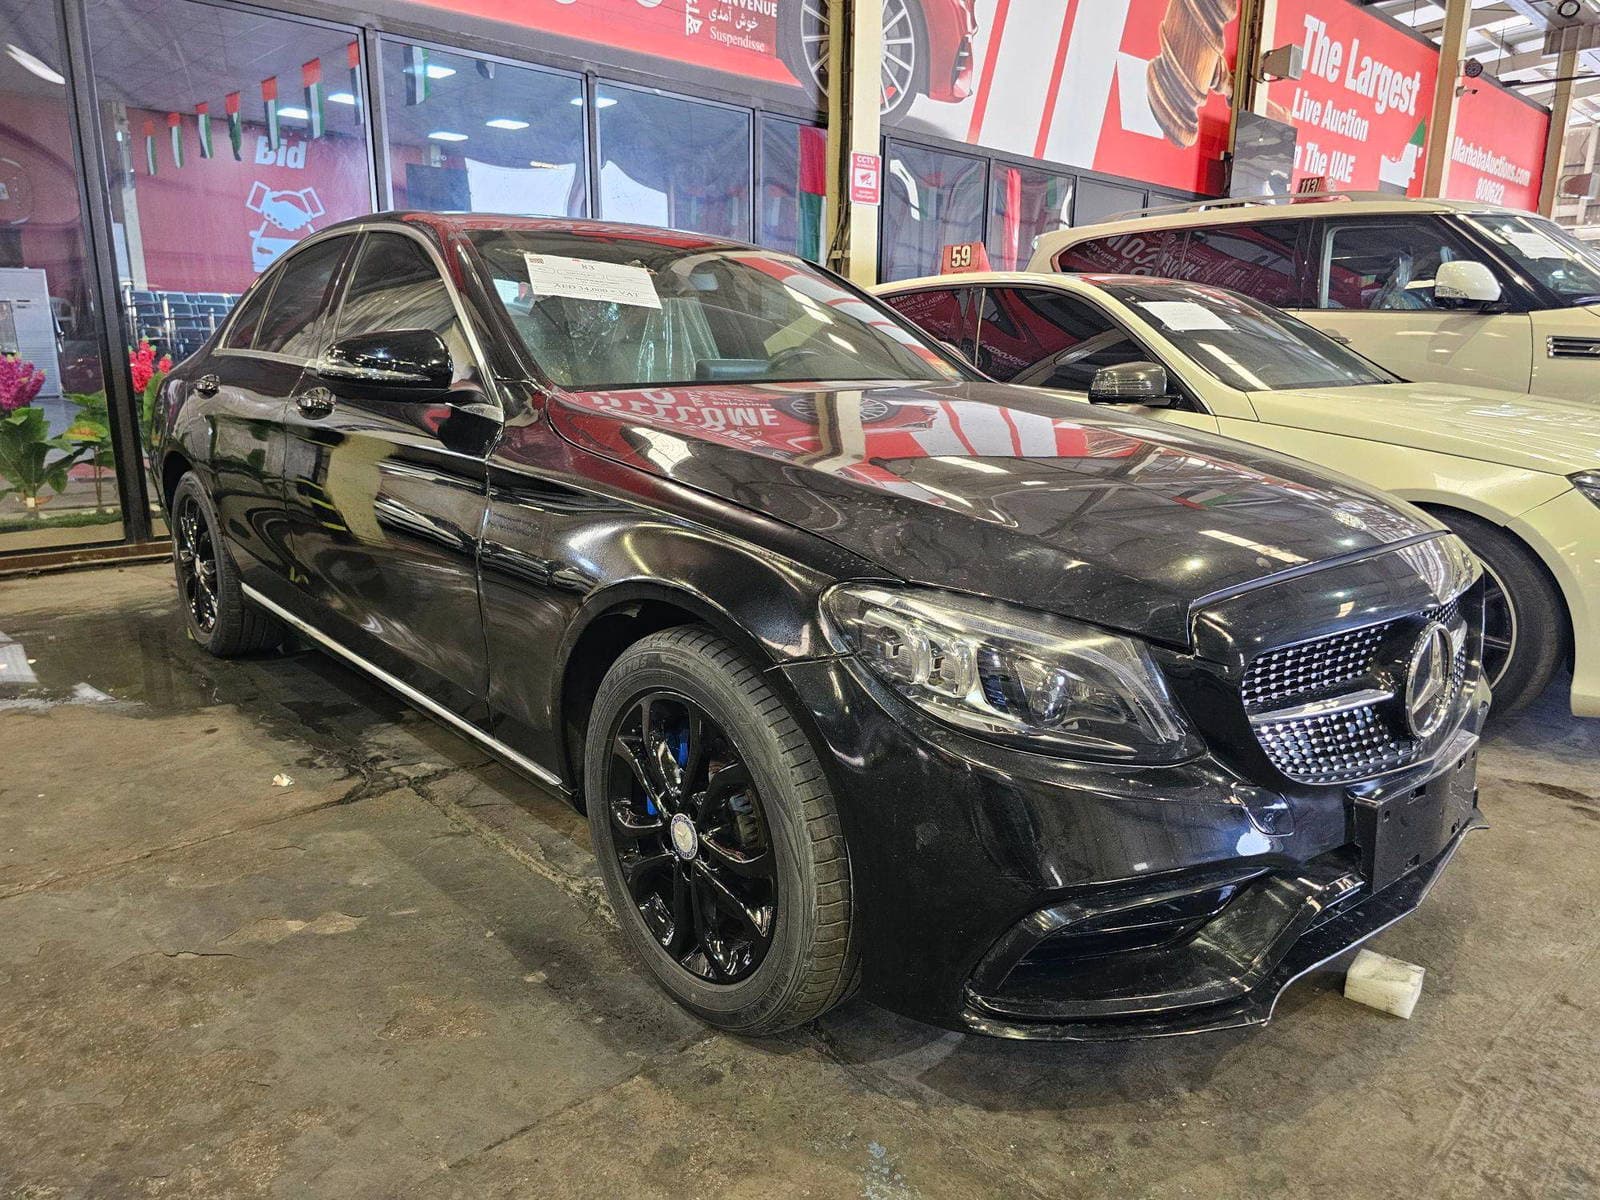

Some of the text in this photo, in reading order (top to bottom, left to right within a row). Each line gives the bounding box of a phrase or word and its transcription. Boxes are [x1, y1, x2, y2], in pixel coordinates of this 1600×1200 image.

[709, 26, 765, 52] Suspendisse
[1301, 14, 1421, 117] The Largest
[1291, 87, 1370, 142] Live Auction
[255, 135, 307, 169] Bid
[857, 155, 876, 166] CCTV
[1303, 142, 1329, 176] The
[1329, 150, 1357, 183] UAE
[1451, 136, 1530, 187] MarhabaAuctions.com
[951, 245, 971, 267] 59
